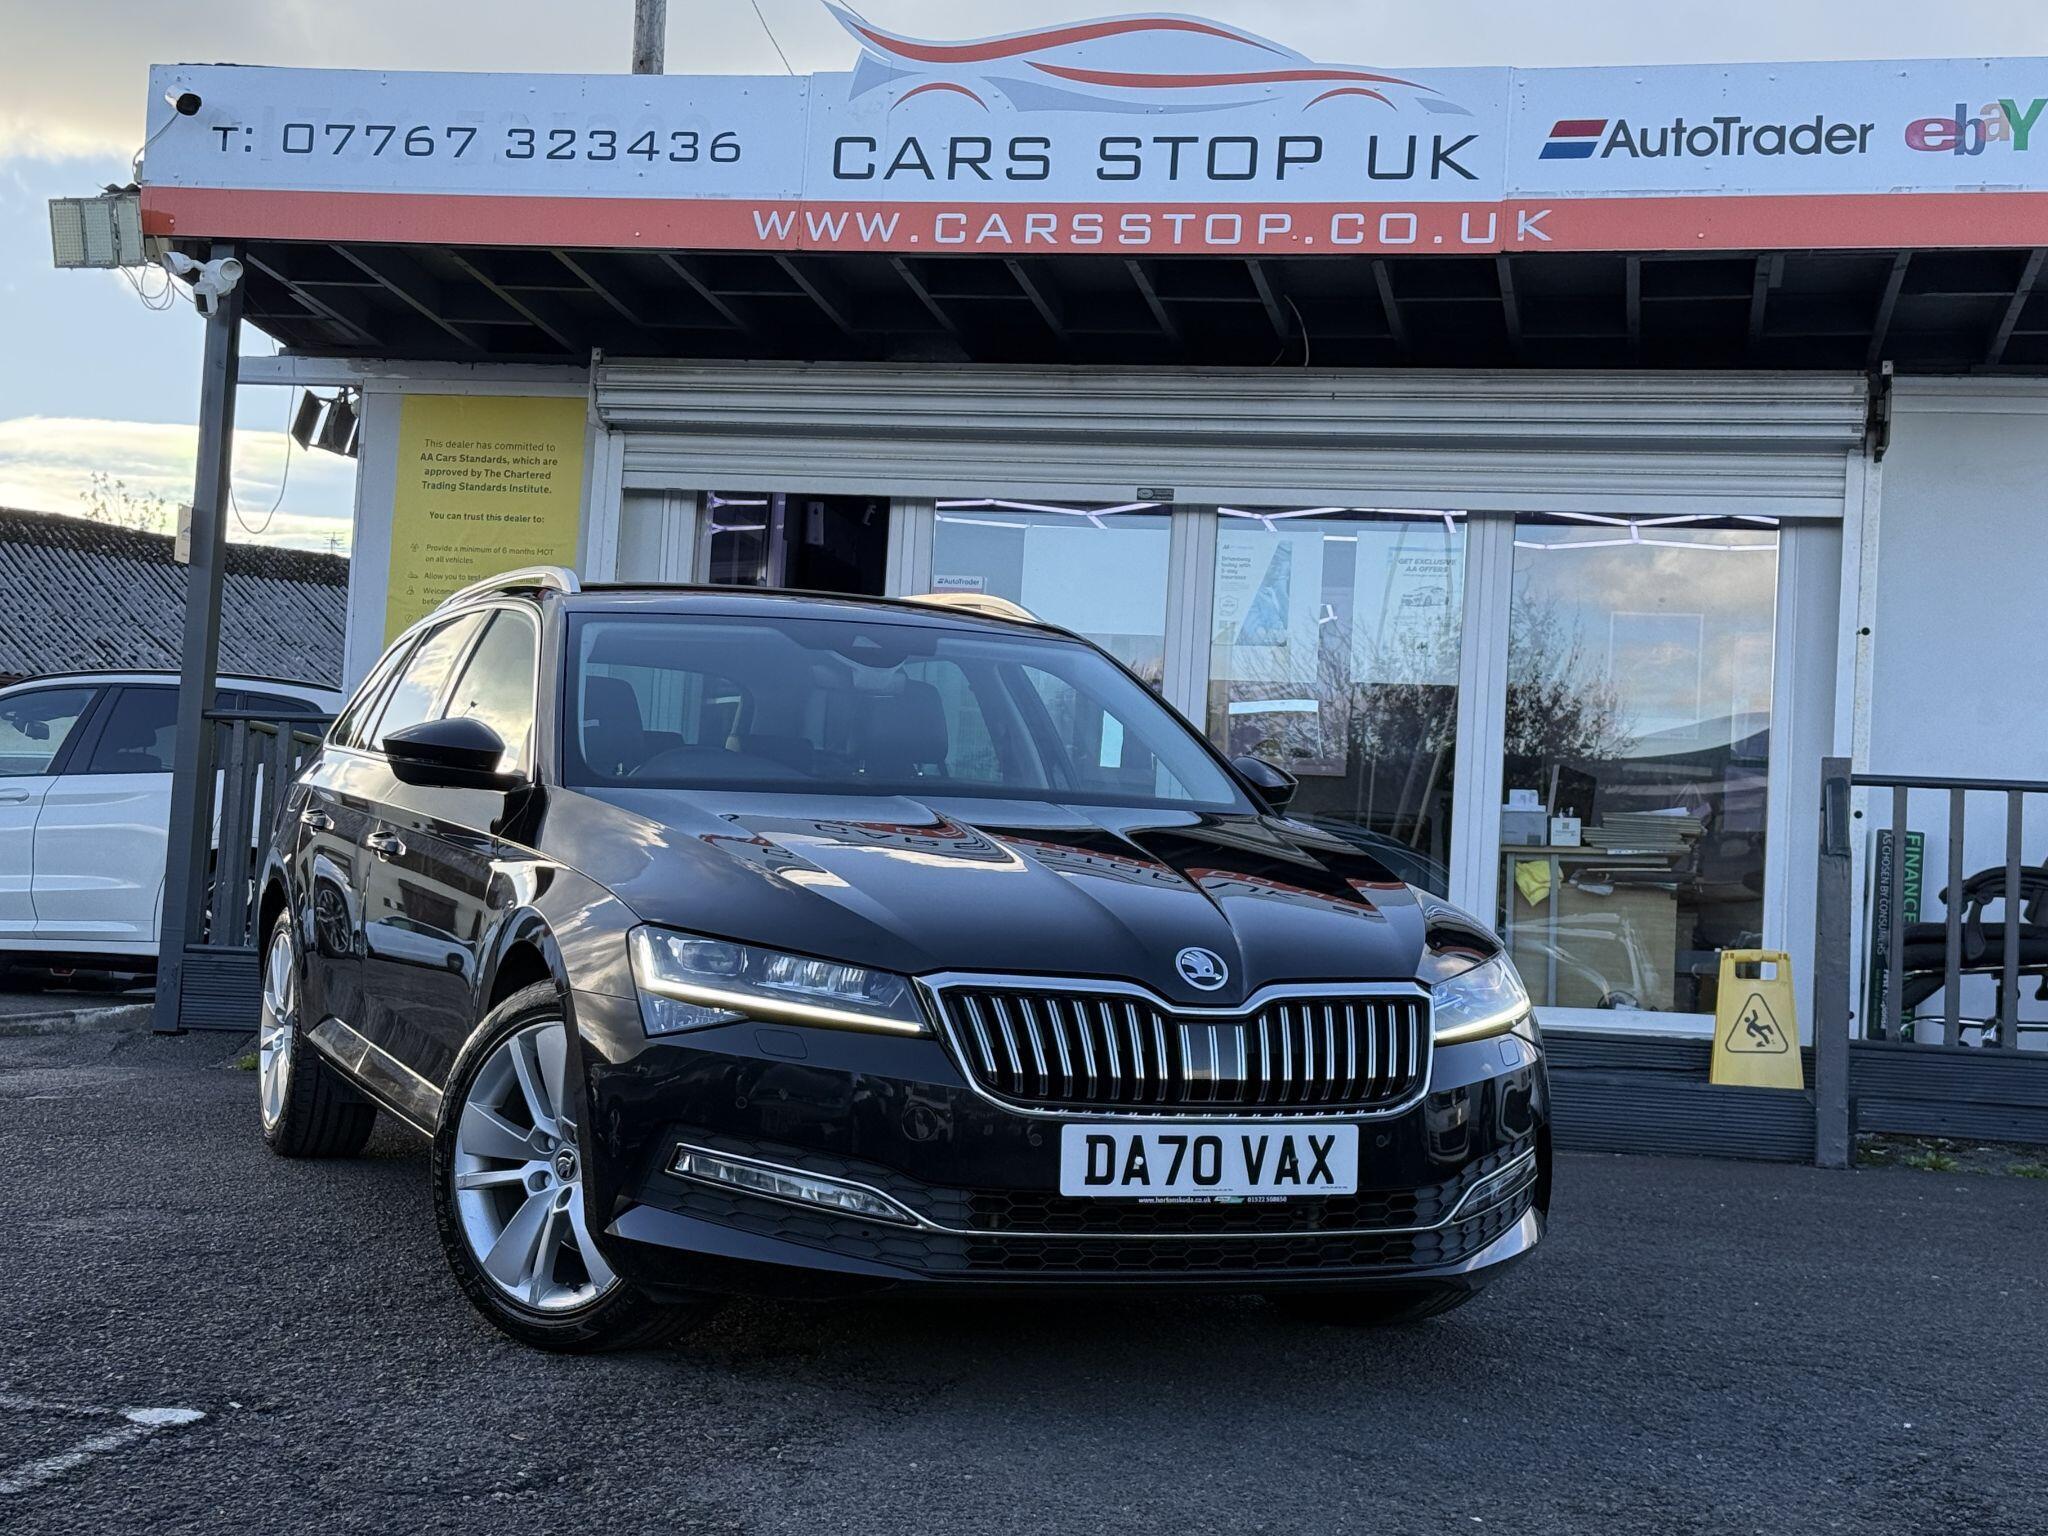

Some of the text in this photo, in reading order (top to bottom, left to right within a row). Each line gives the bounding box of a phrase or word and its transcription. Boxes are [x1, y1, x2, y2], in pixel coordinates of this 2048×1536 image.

[212, 123, 742, 164] T: 07767 323436
[1600, 116, 1875, 159] AutoTrader
[832, 134, 1481, 182] CARS STOP UK
[425, 439, 556, 452] This dealer has committed to
[420, 453, 559, 466] AA Cars Standards, which are
[424, 468, 552, 480] approved by The Chartered
[421, 481, 552, 494] Trading Standards Institute.
[429, 511, 445, 520] You
[463, 513, 484, 521] trust
[486, 513, 502, 521] this
[503, 514, 531, 523] dealer
[533, 515, 545, 523] to:
[426, 543, 452, 552] Provide
[459, 546, 492, 554] minimum
[493, 546, 501, 554] of
[508, 547, 535, 556] months
[536, 548, 555, 556] MOT
[445, 556, 474, 564] vehicles
[424, 571, 445, 580] Allow
[445, 573, 457, 582] you
[943, 578, 980, 586] AutoTrader
[1880, 845, 1891, 884] CHOSEN
[1903, 834, 1921, 924] FINANCE
[1084, 1134, 1336, 1186] DA70 VAX
